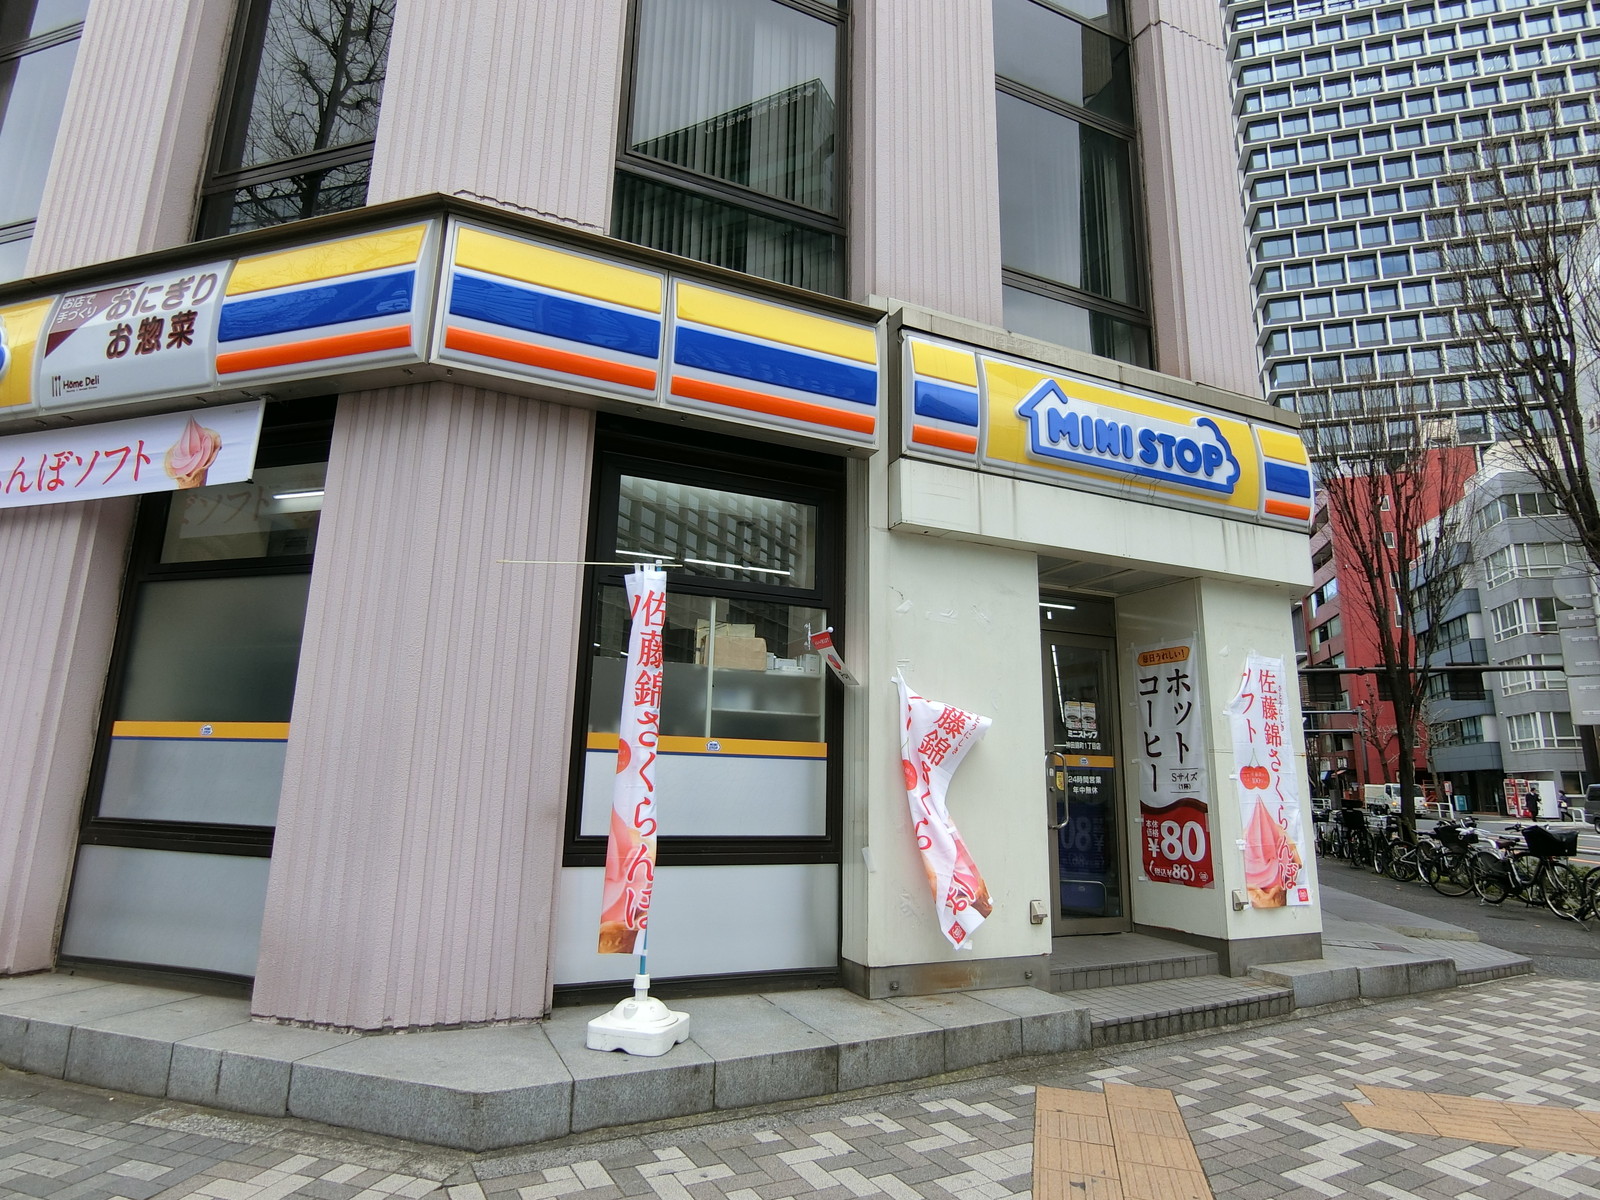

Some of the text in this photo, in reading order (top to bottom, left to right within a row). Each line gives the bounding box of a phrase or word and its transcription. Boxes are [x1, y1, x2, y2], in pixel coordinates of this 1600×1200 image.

[62, 293, 97, 309] お店で
[105, 272, 218, 321] おにぎり
[57, 305, 97, 324] 手づくり
[106, 309, 198, 359] お惣菜
[63, 380, 84, 390] Home
[85, 375, 100, 386] Deli
[1047, 407, 1224, 477] MINI STOP
[0, 440, 152, 494] んぼソフト
[1166, 668, 1192, 764] ホット
[1067, 730, 1098, 739] ミニストップ
[1139, 675, 1162, 793] コーヒー
[1068, 776, 1102, 784] 24時間営業
[1072, 786, 1098, 794] 年中無休
[1171, 772, 1198, 782] Sサイズ
[1258, 669, 1299, 890] 佐藤錦さくらんぼ
